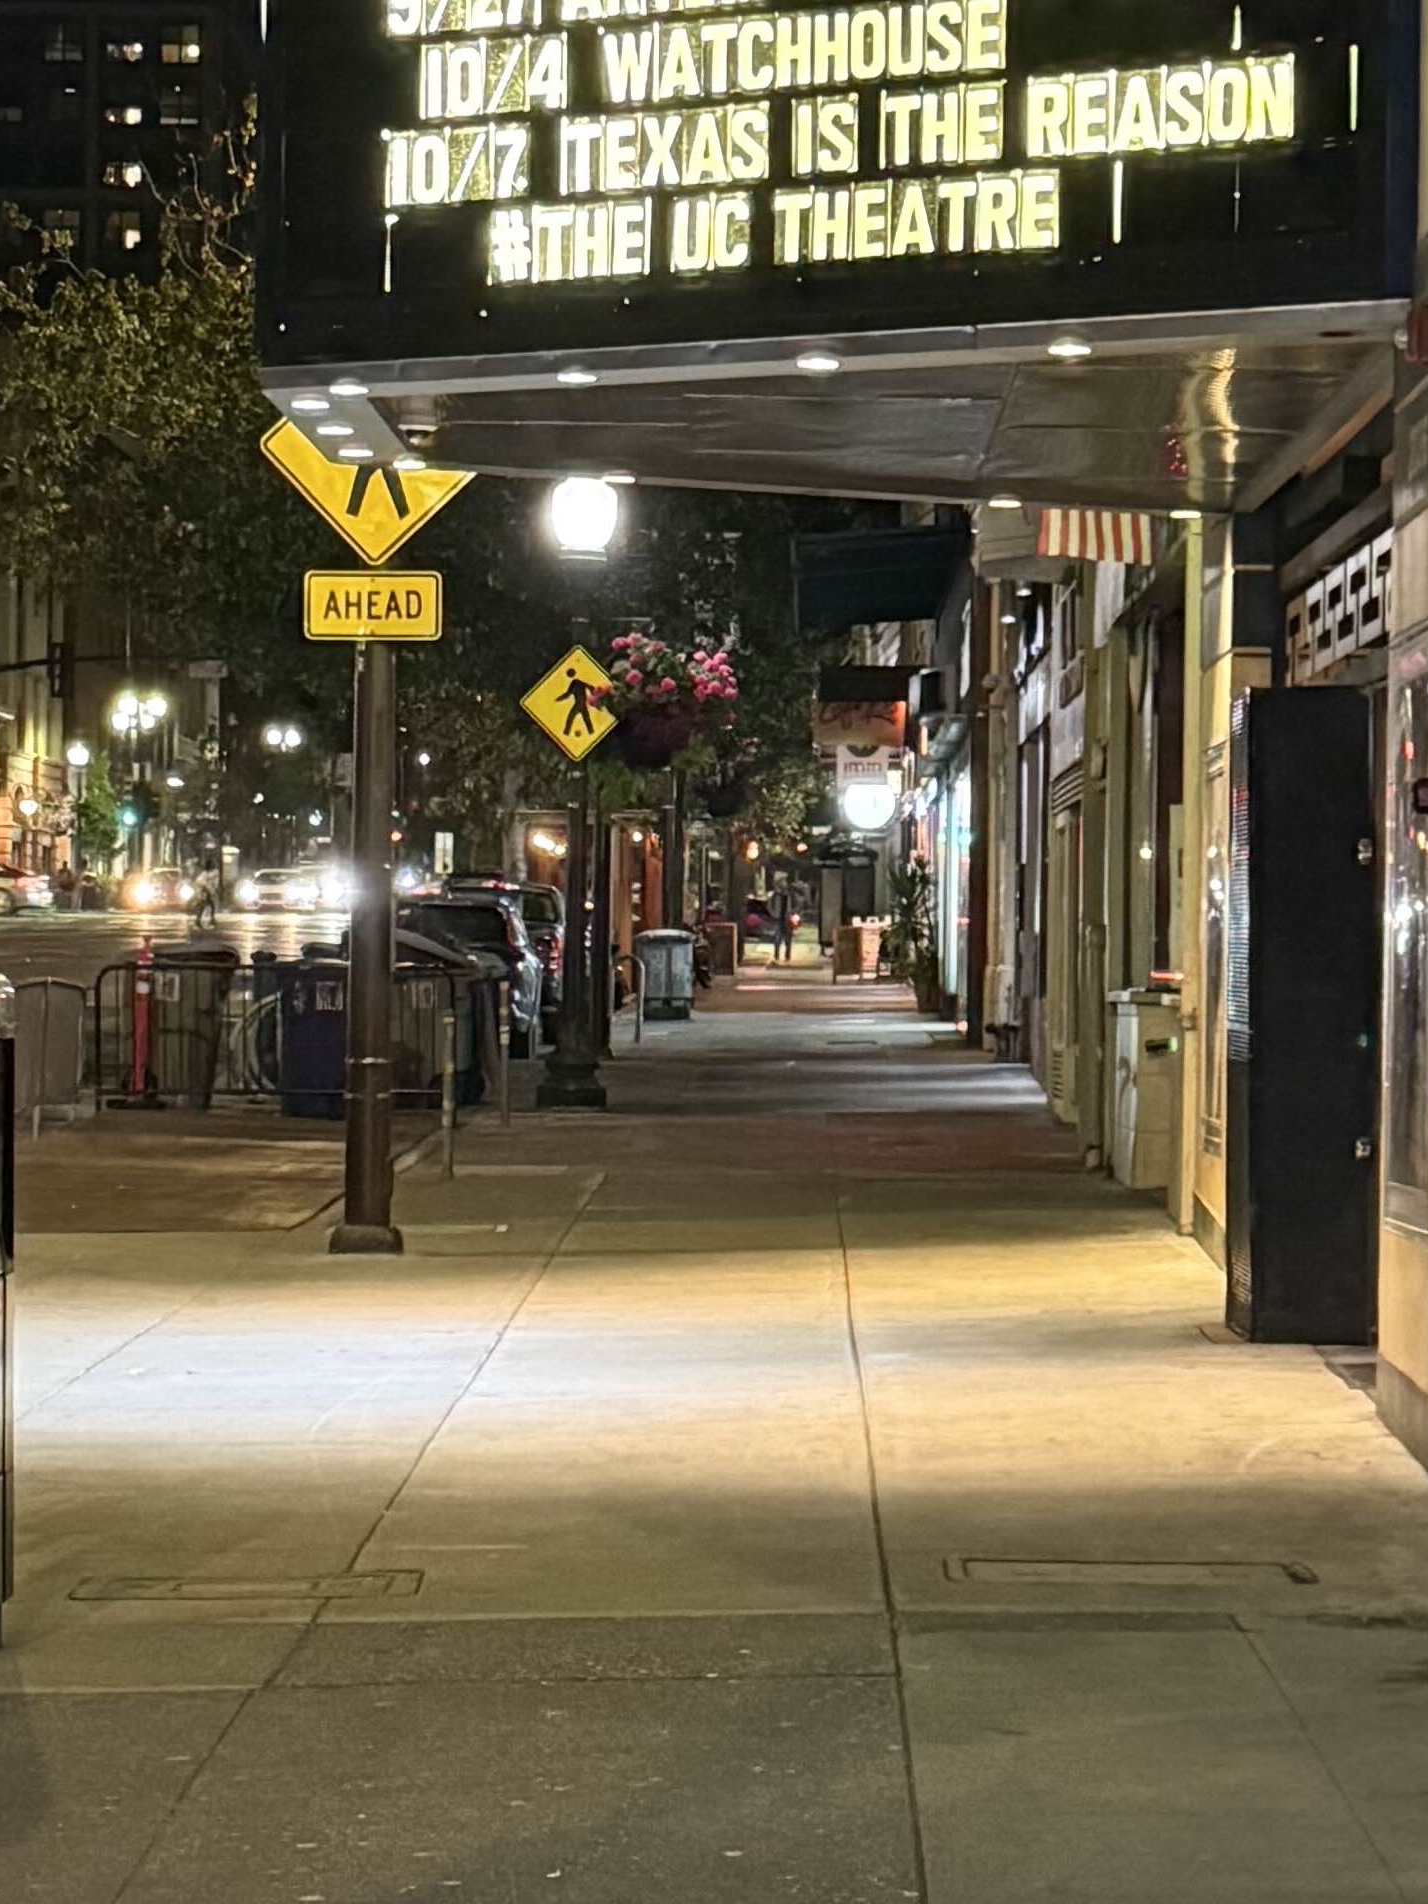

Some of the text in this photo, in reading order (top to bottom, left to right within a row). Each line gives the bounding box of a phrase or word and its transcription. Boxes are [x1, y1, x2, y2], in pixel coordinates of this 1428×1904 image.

[423, 39, 564, 117] 10/4
[387, 60, 1293, 204] 10/7 TEXAS IS THE REASON
[491, 172, 1056, 282] #THE UC THEATRE
[324, 590, 422, 621] AHEAD
